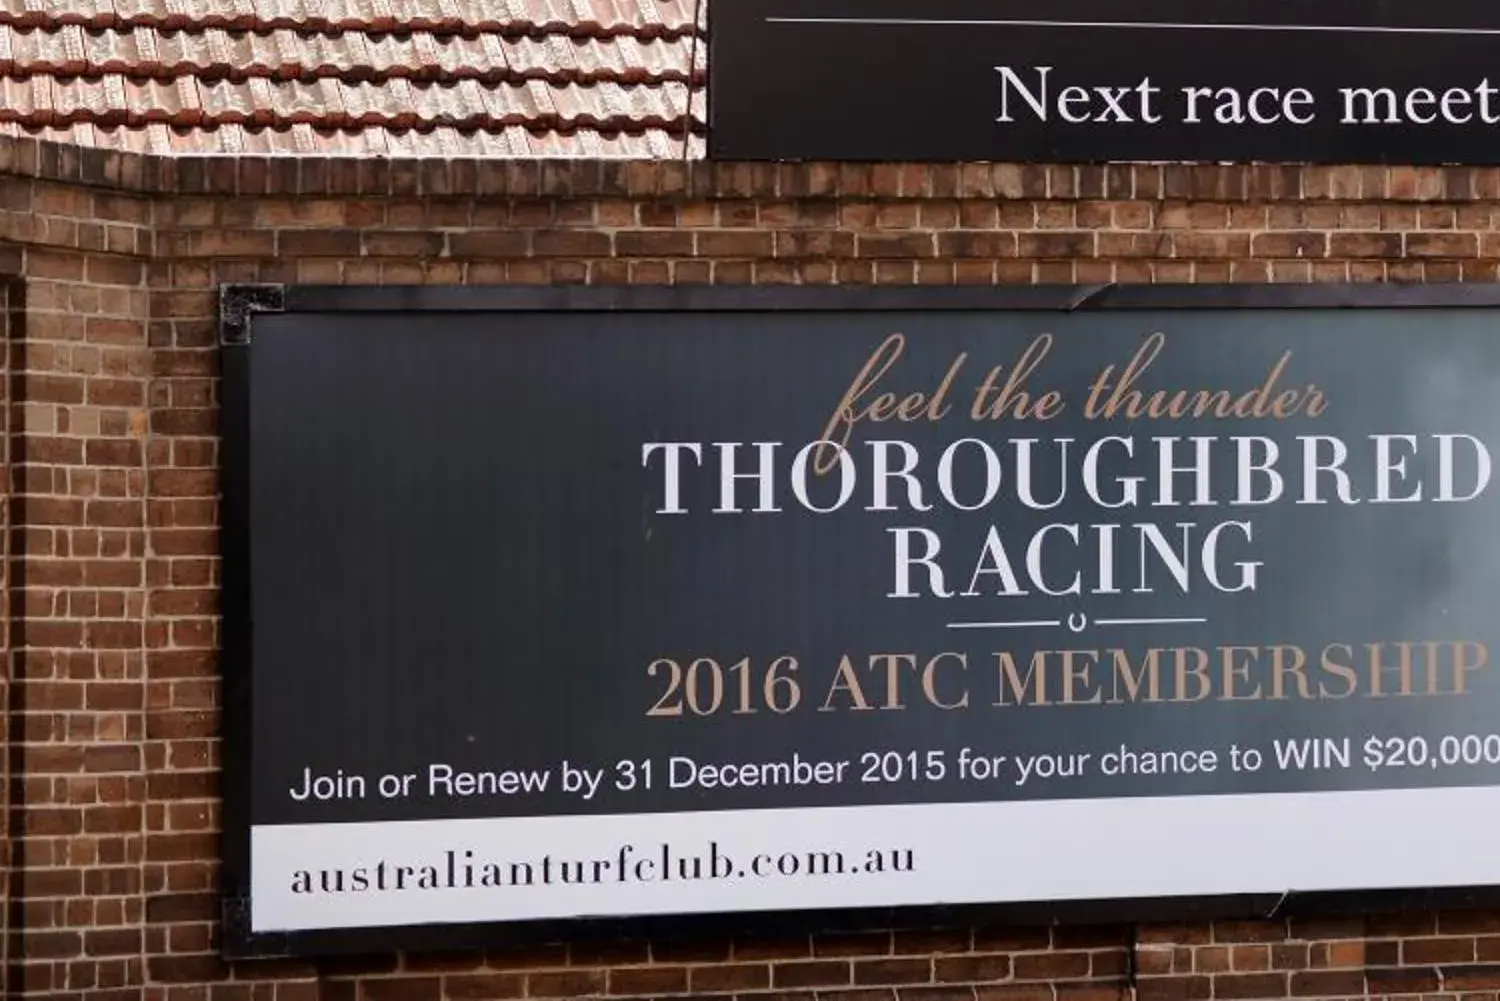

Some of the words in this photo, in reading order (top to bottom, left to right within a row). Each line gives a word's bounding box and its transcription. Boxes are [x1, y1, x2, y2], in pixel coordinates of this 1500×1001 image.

[994, 67, 1160, 123] Next
[1182, 87, 1314, 123] race
[814, 332, 968, 475] feel
[971, 334, 1062, 420] the
[1085, 333, 1329, 418] thunder
[641, 433, 1492, 515] THOROUGHBRED
[887, 521, 1264, 597] RACING
[646, 657, 800, 715] 2016
[818, 653, 968, 711] ATC
[992, 641, 1489, 707] MEMBERSHIP
[290, 768, 364, 800] Join
[379, 775, 416, 797] or
[430, 765, 549, 795] Renew
[563, 761, 603, 799] by
[616, 759, 650, 790] 31
[670, 753, 849, 788] December
[861, 751, 945, 781] 2015
[958, 748, 1006, 779] for
[1016, 754, 1090, 785] your
[1101, 744, 1217, 775] chance
[1230, 745, 1262, 771] to
[1274, 738, 1350, 769] WIN
[291, 843, 916, 894] australianturfclub.com.au
